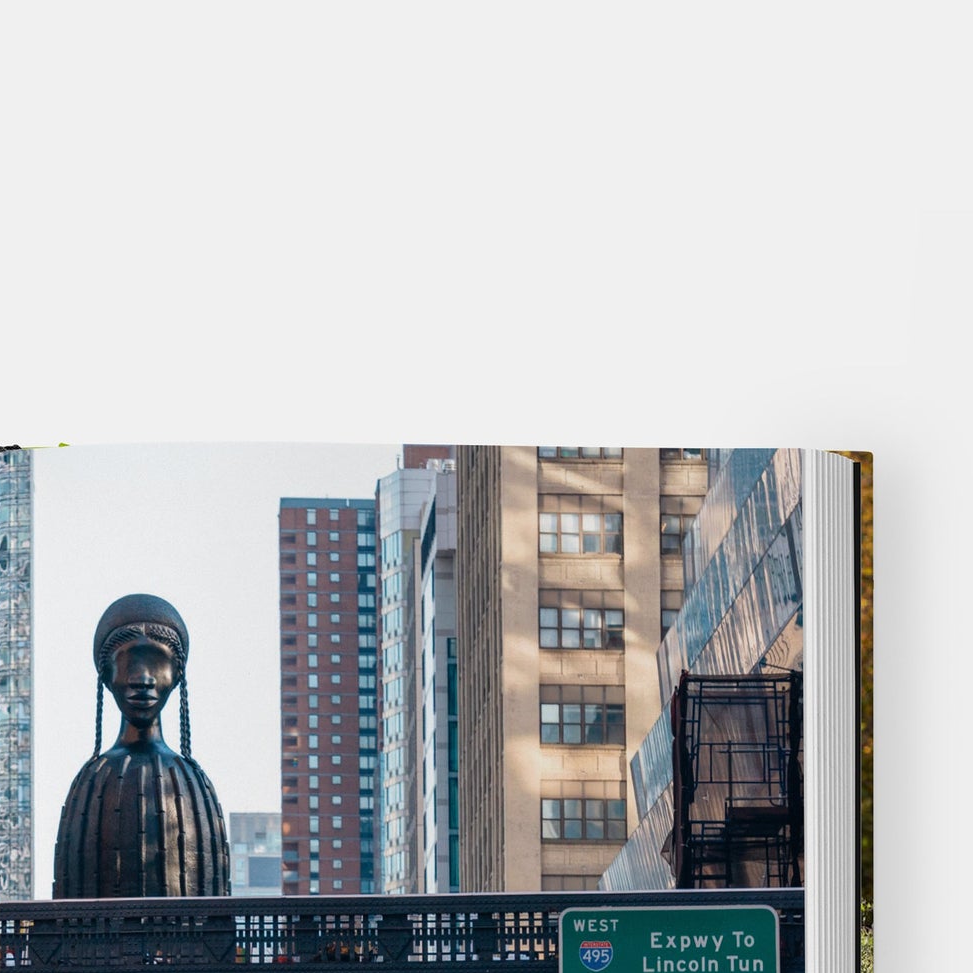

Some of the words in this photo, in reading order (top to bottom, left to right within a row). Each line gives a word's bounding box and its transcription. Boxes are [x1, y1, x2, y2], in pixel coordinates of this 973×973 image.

[573, 919, 619, 932] WEST
[650, 932, 724, 951] Expwy
[732, 931, 755, 948] To
[582, 949, 610, 963] 495
[643, 956, 719, 972] Lincoln
[726, 955, 764, 972] Tun
